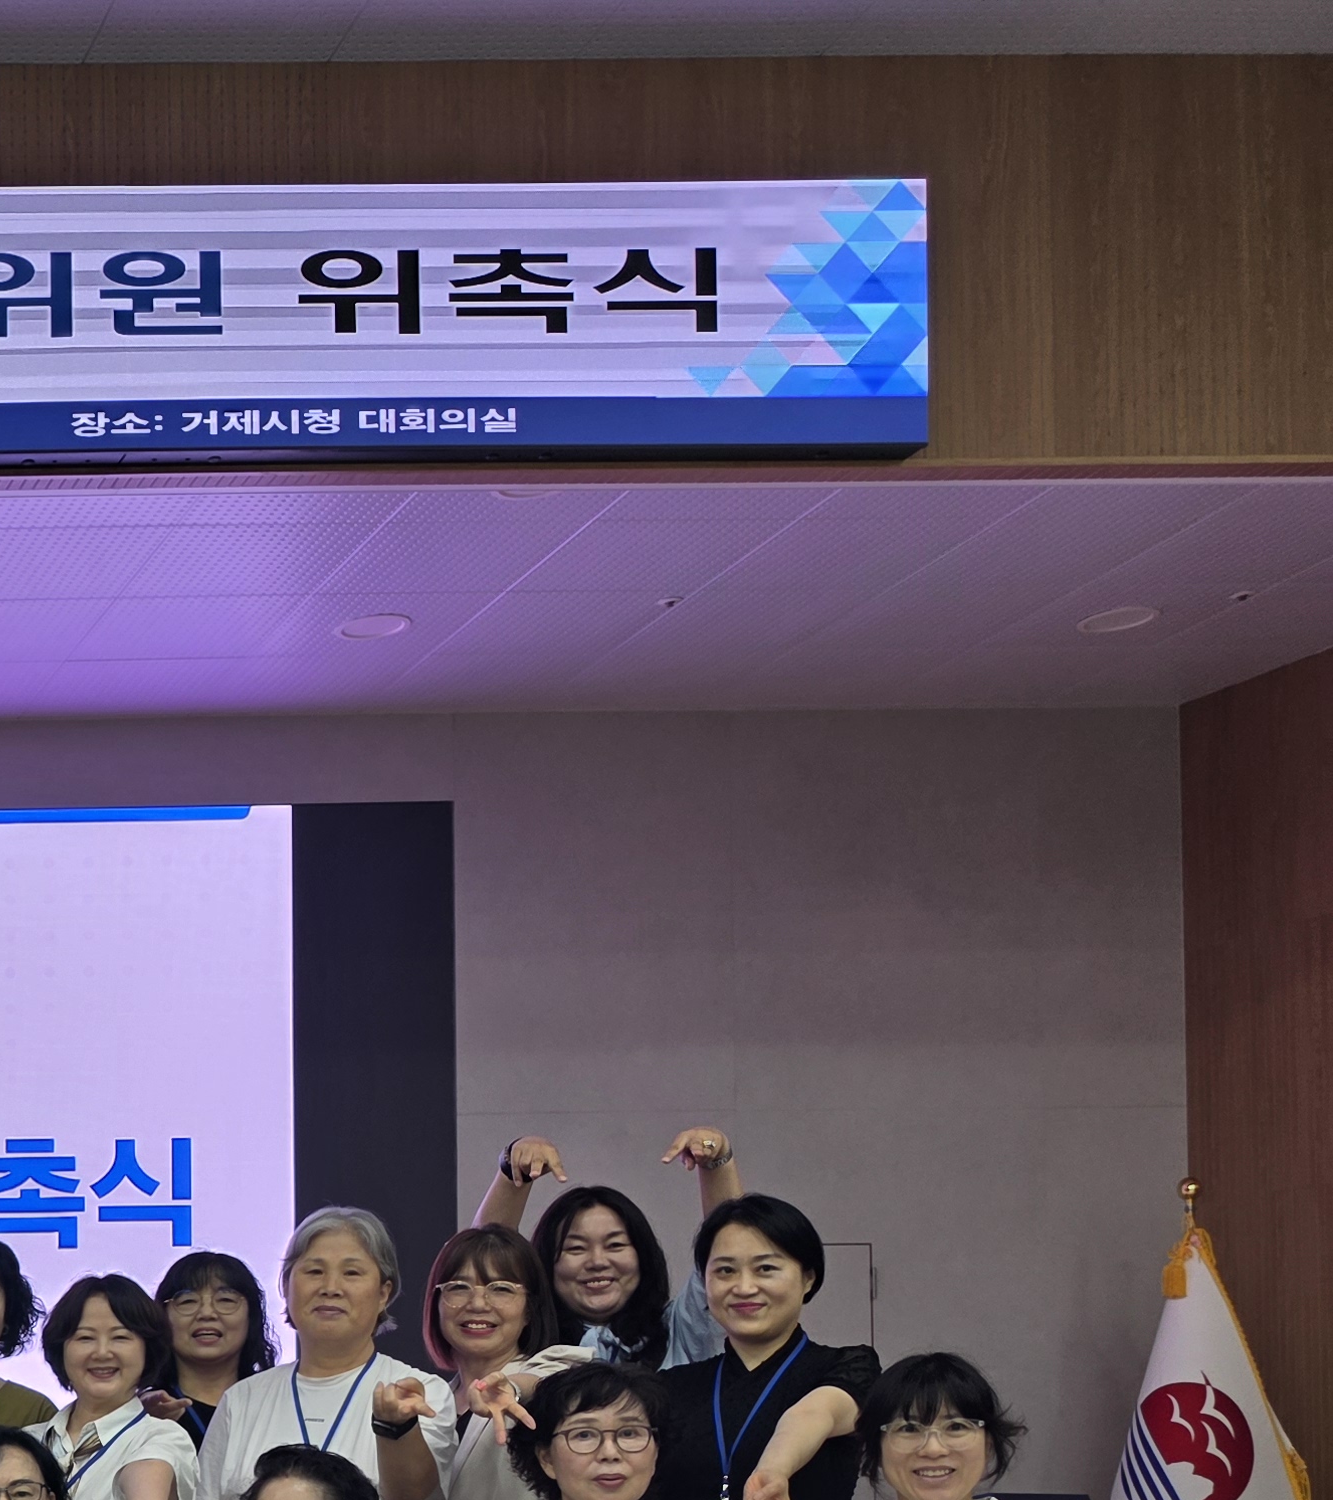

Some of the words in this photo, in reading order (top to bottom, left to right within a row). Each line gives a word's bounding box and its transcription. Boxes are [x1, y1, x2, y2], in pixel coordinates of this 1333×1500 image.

[297, 247, 719, 335] 위촉식
[70, 411, 163, 438] 장소:
[181, 407, 341, 436] 거제시청
[358, 406, 518, 434] 대회의실
